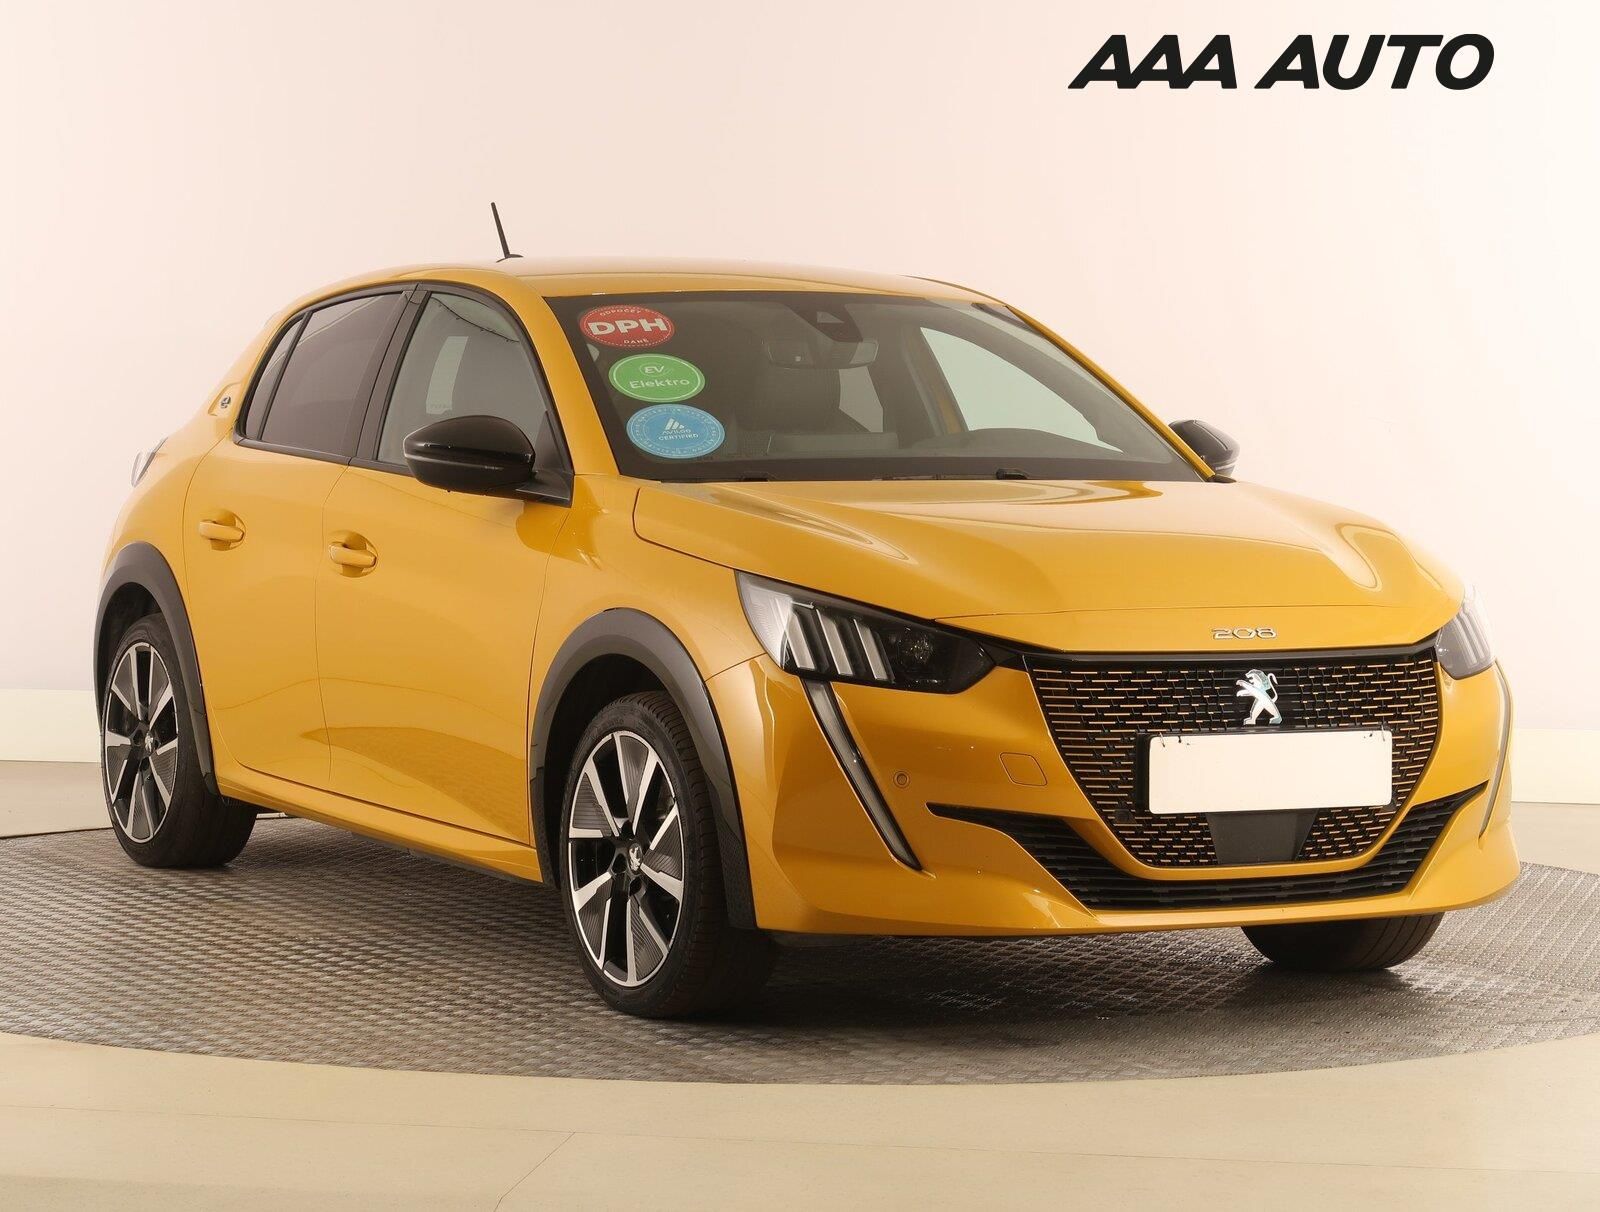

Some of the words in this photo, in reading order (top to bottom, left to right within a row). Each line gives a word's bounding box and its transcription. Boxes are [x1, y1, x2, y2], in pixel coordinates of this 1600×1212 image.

[587, 318, 668, 336] DPH
[643, 365, 665, 374] EV
[629, 378, 690, 389] Elektro
[658, 433, 699, 441] CERTIFIED
[1211, 627, 1277, 640] 208
